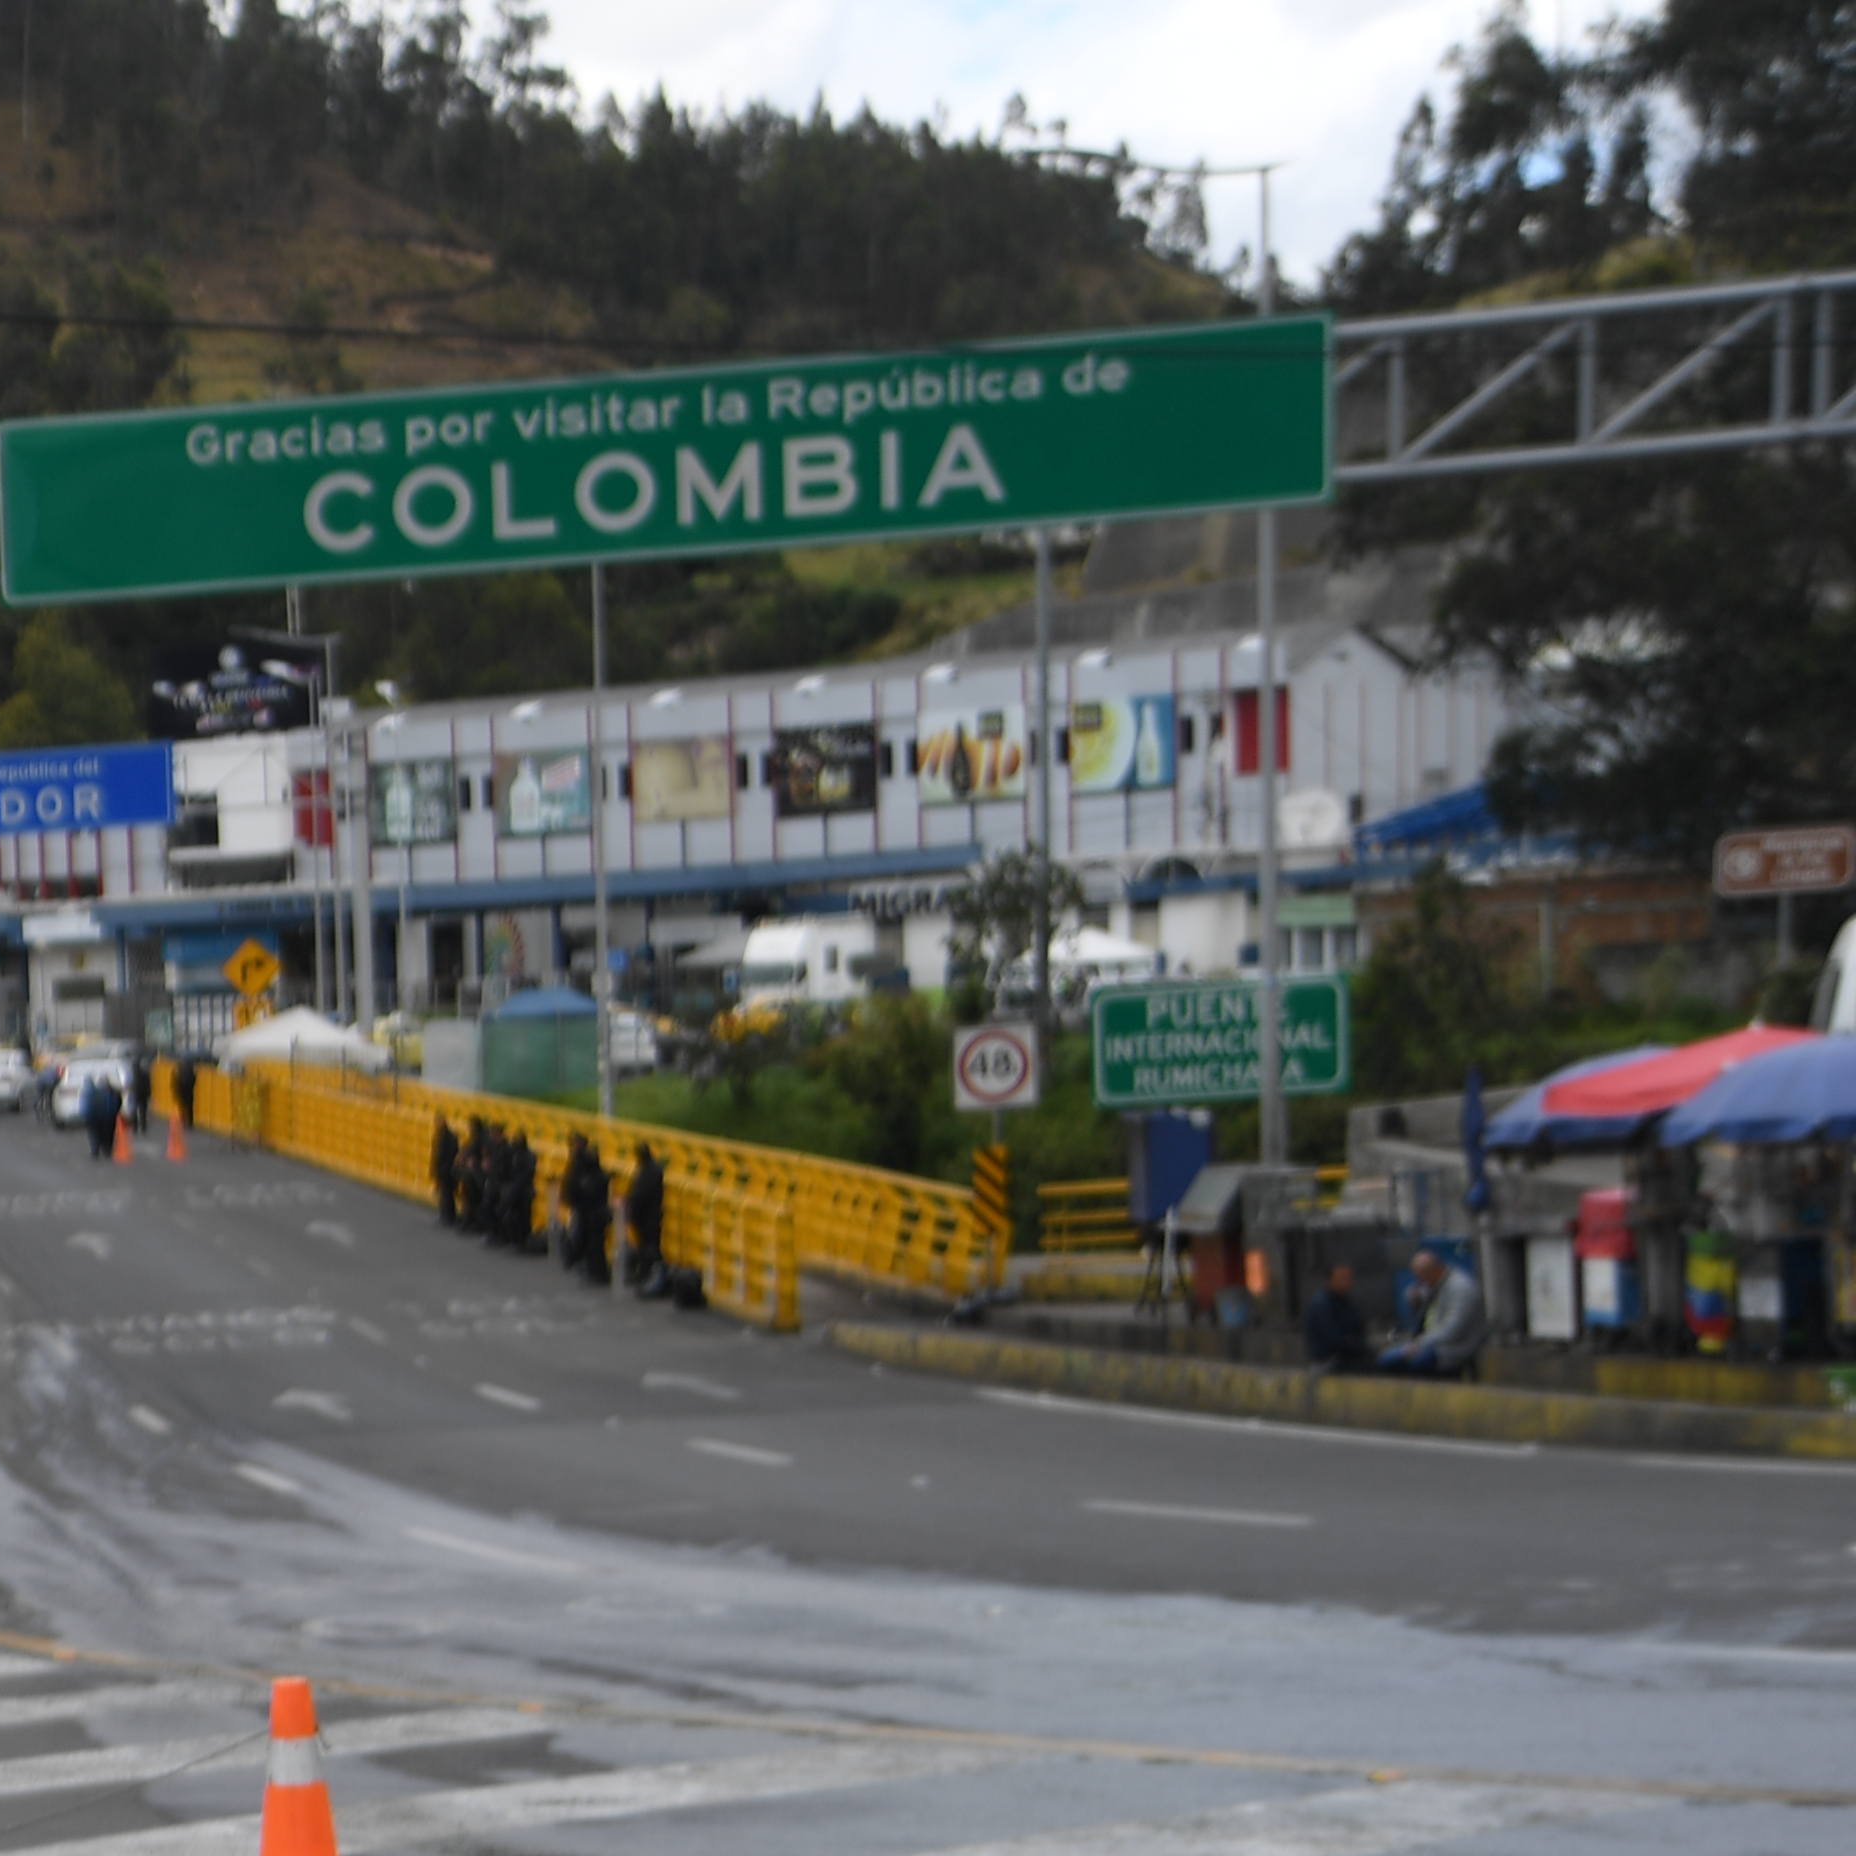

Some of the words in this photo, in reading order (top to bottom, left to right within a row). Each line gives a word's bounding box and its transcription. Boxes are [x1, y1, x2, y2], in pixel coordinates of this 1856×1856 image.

[186, 416, 386, 466] Gracias
[404, 411, 493, 457] por
[512, 393, 680, 441] visitar
[702, 384, 749, 425] la
[767, 363, 1042, 425] República
[1062, 352, 1131, 396] de
[303, 423, 1006, 553] COLOMBIA
